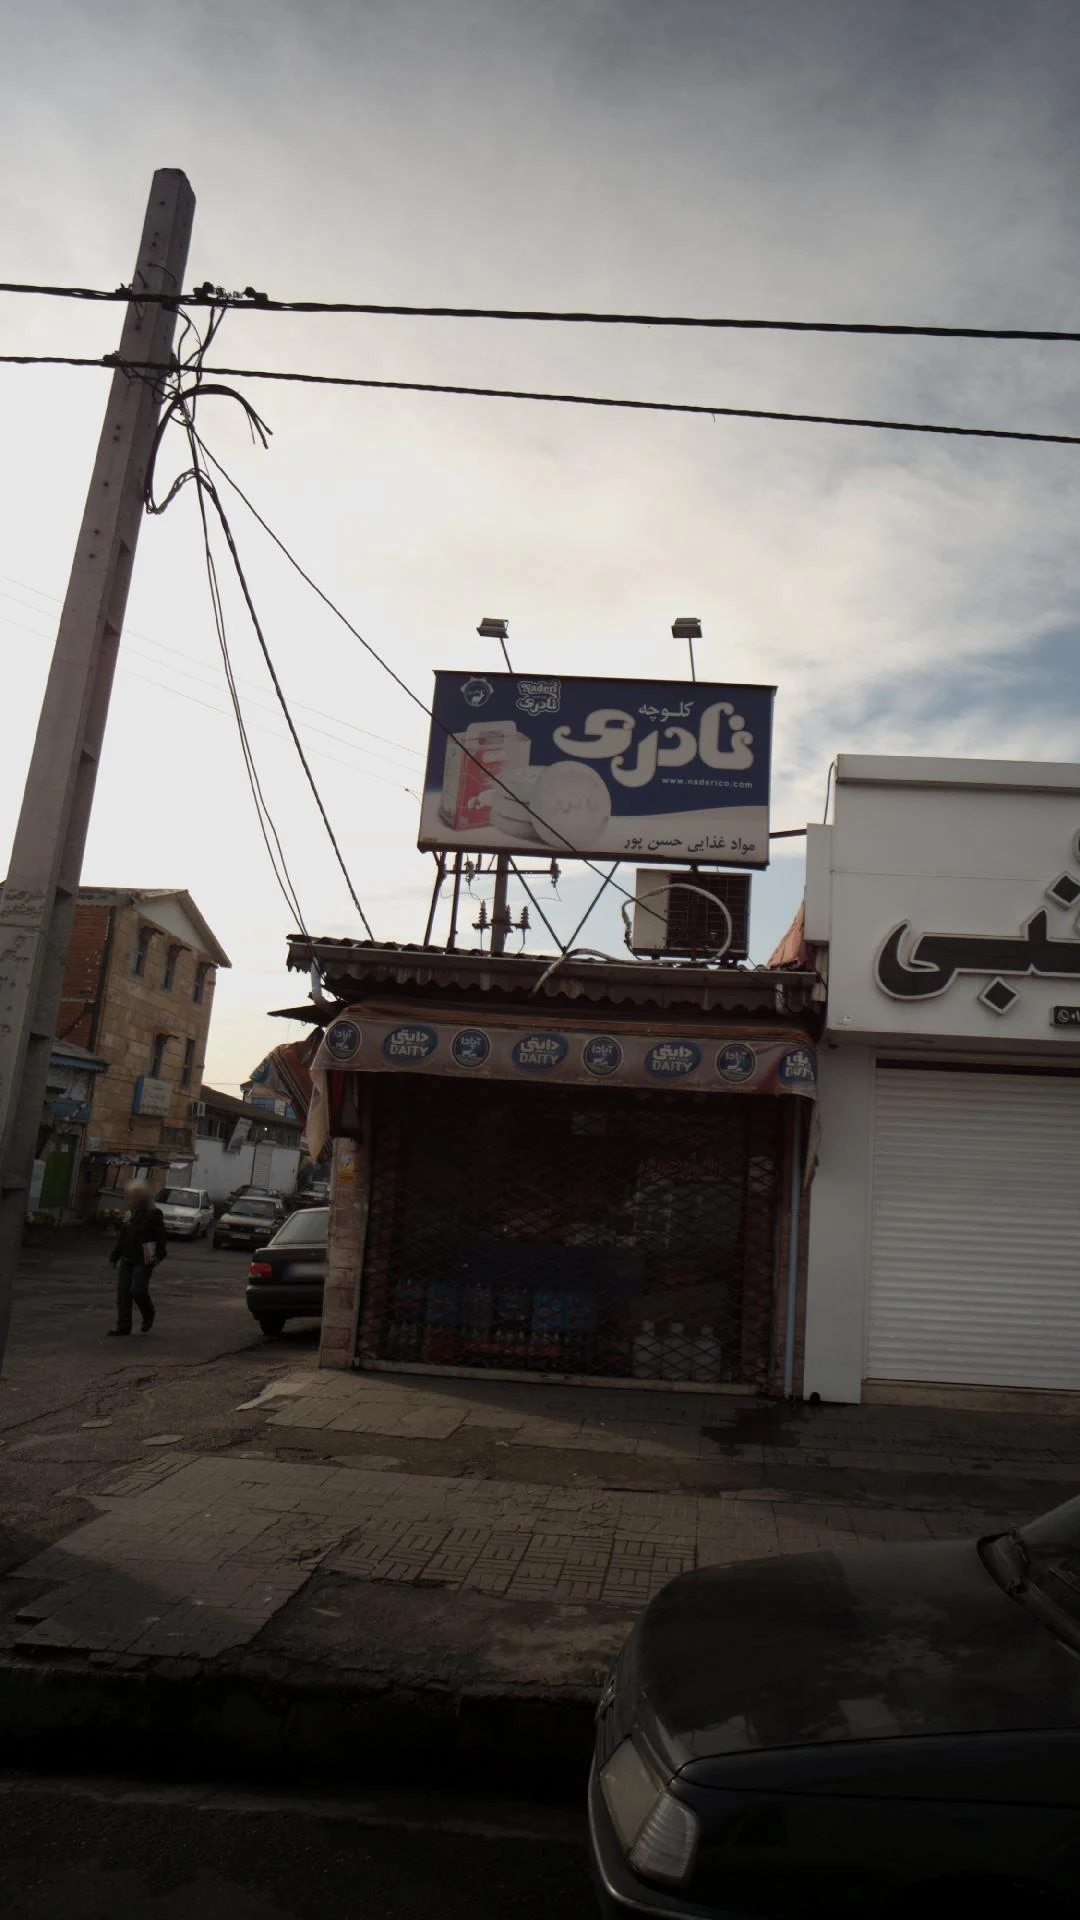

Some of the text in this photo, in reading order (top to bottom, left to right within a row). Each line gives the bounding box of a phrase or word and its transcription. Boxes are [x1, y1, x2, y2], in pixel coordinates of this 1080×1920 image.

[521, 681, 558, 694] Naderi
[518, 697, 558, 713] نادری
[638, 701, 694, 722] کلوچه
[553, 701, 755, 788] نادری
[661, 777, 754, 789] www.naderico.com
[624, 835, 756, 855] مواد غذایی حسن پور
[391, 1028, 430, 1046] دایتی
[520, 1036, 560, 1053] دایتی
[389, 1044, 429, 1057] DAITY
[519, 1052, 560, 1065] DAITY
[652, 1044, 693, 1061] دایتی
[652, 1060, 693, 1073] DAITY
